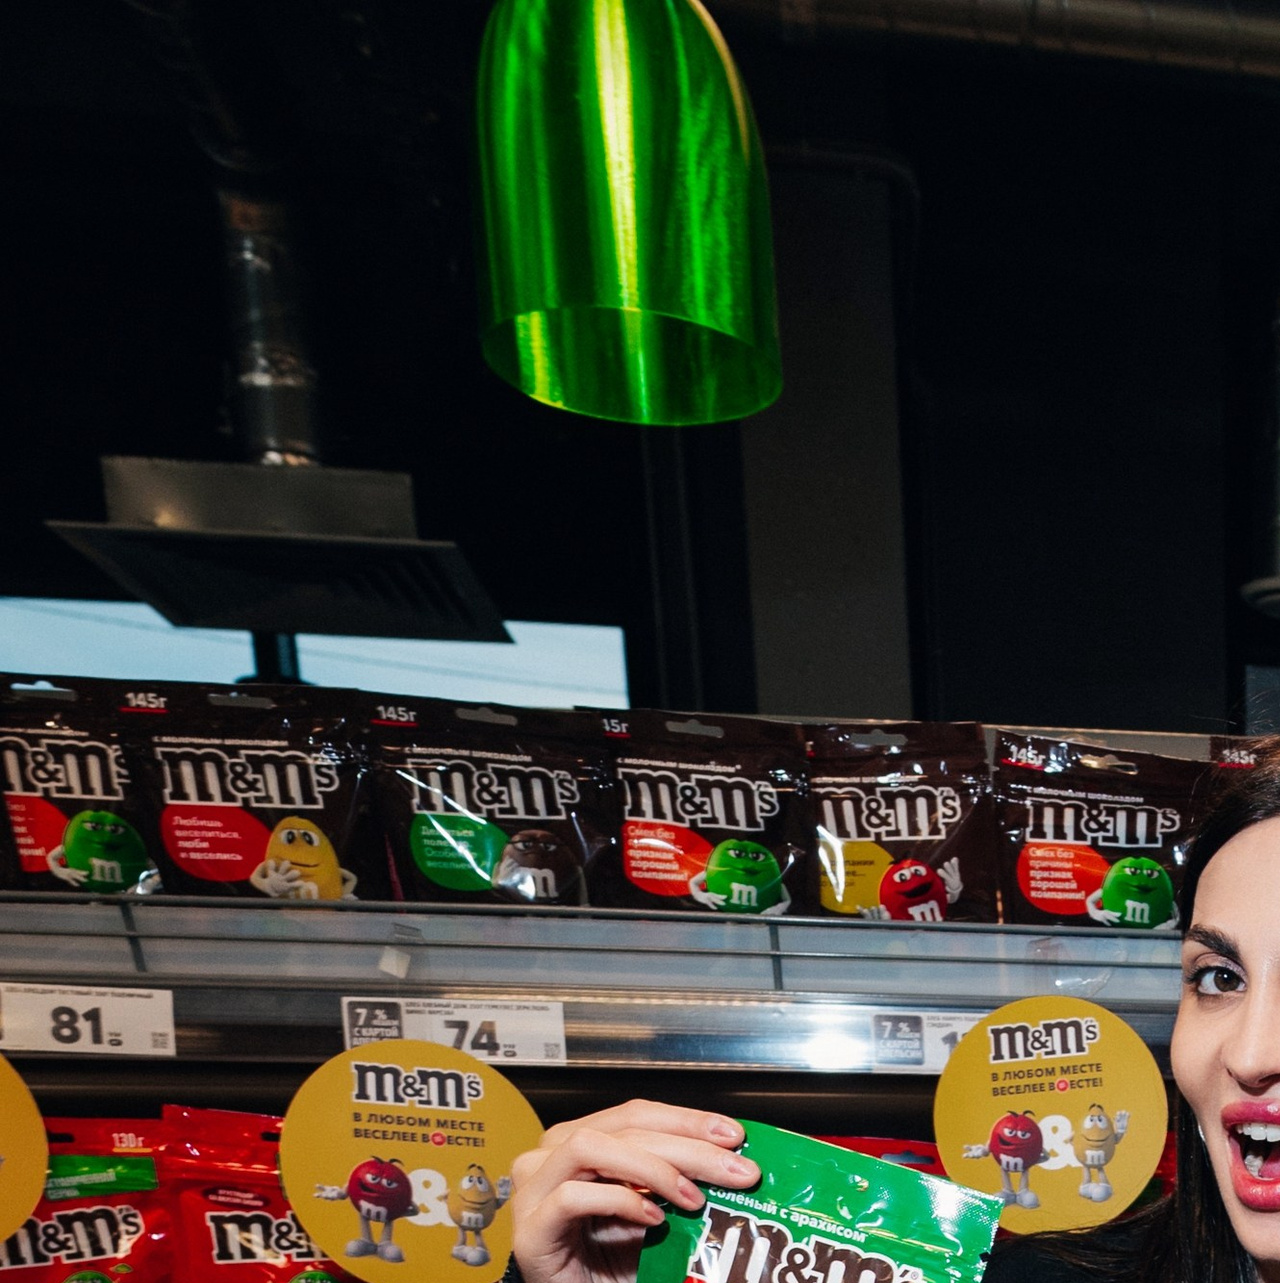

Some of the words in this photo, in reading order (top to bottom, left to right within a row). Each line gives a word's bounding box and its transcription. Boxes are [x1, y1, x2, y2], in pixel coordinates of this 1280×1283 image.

[124, 691, 168, 709] 145г
[376, 705, 418, 722] 145г
[1008, 745, 1046, 766] 145г
[154, 746, 341, 810] m&m's
[406, 758, 580, 820] m&m's
[616, 766, 780, 832] m&m's
[1025, 797, 1181, 848] m&m's
[88, 858, 124, 883] m
[729, 882, 759, 908] m
[1123, 900, 1151, 925] m
[50, 1006, 105, 1045] 81
[355, 1008, 369, 1026] 7
[443, 1020, 501, 1057] 74
[988, 1016, 1101, 1063] m&m's
[990, 1072, 1001, 1083] В
[1003, 1066, 1057, 1081] ЛЮБОМ
[1060, 1062, 1103, 1077] МЕСТЕ
[351, 1061, 485, 1112] m&m's
[992, 1083, 1047, 1097] ВЕСЕЛЕЕ
[353, 1111, 363, 1122] В
[367, 1113, 431, 1128] ЛЮБОМ
[436, 1119, 486, 1133] МЕСТЕ
[111, 1133, 146, 1148] 130г
[353, 1127, 418, 1143] ВЕСЕЛЕЕ
[708, 1187, 779, 1216] солёный
[779, 1208, 788, 1219] с
[790, 1212, 868, 1244] арахисом
